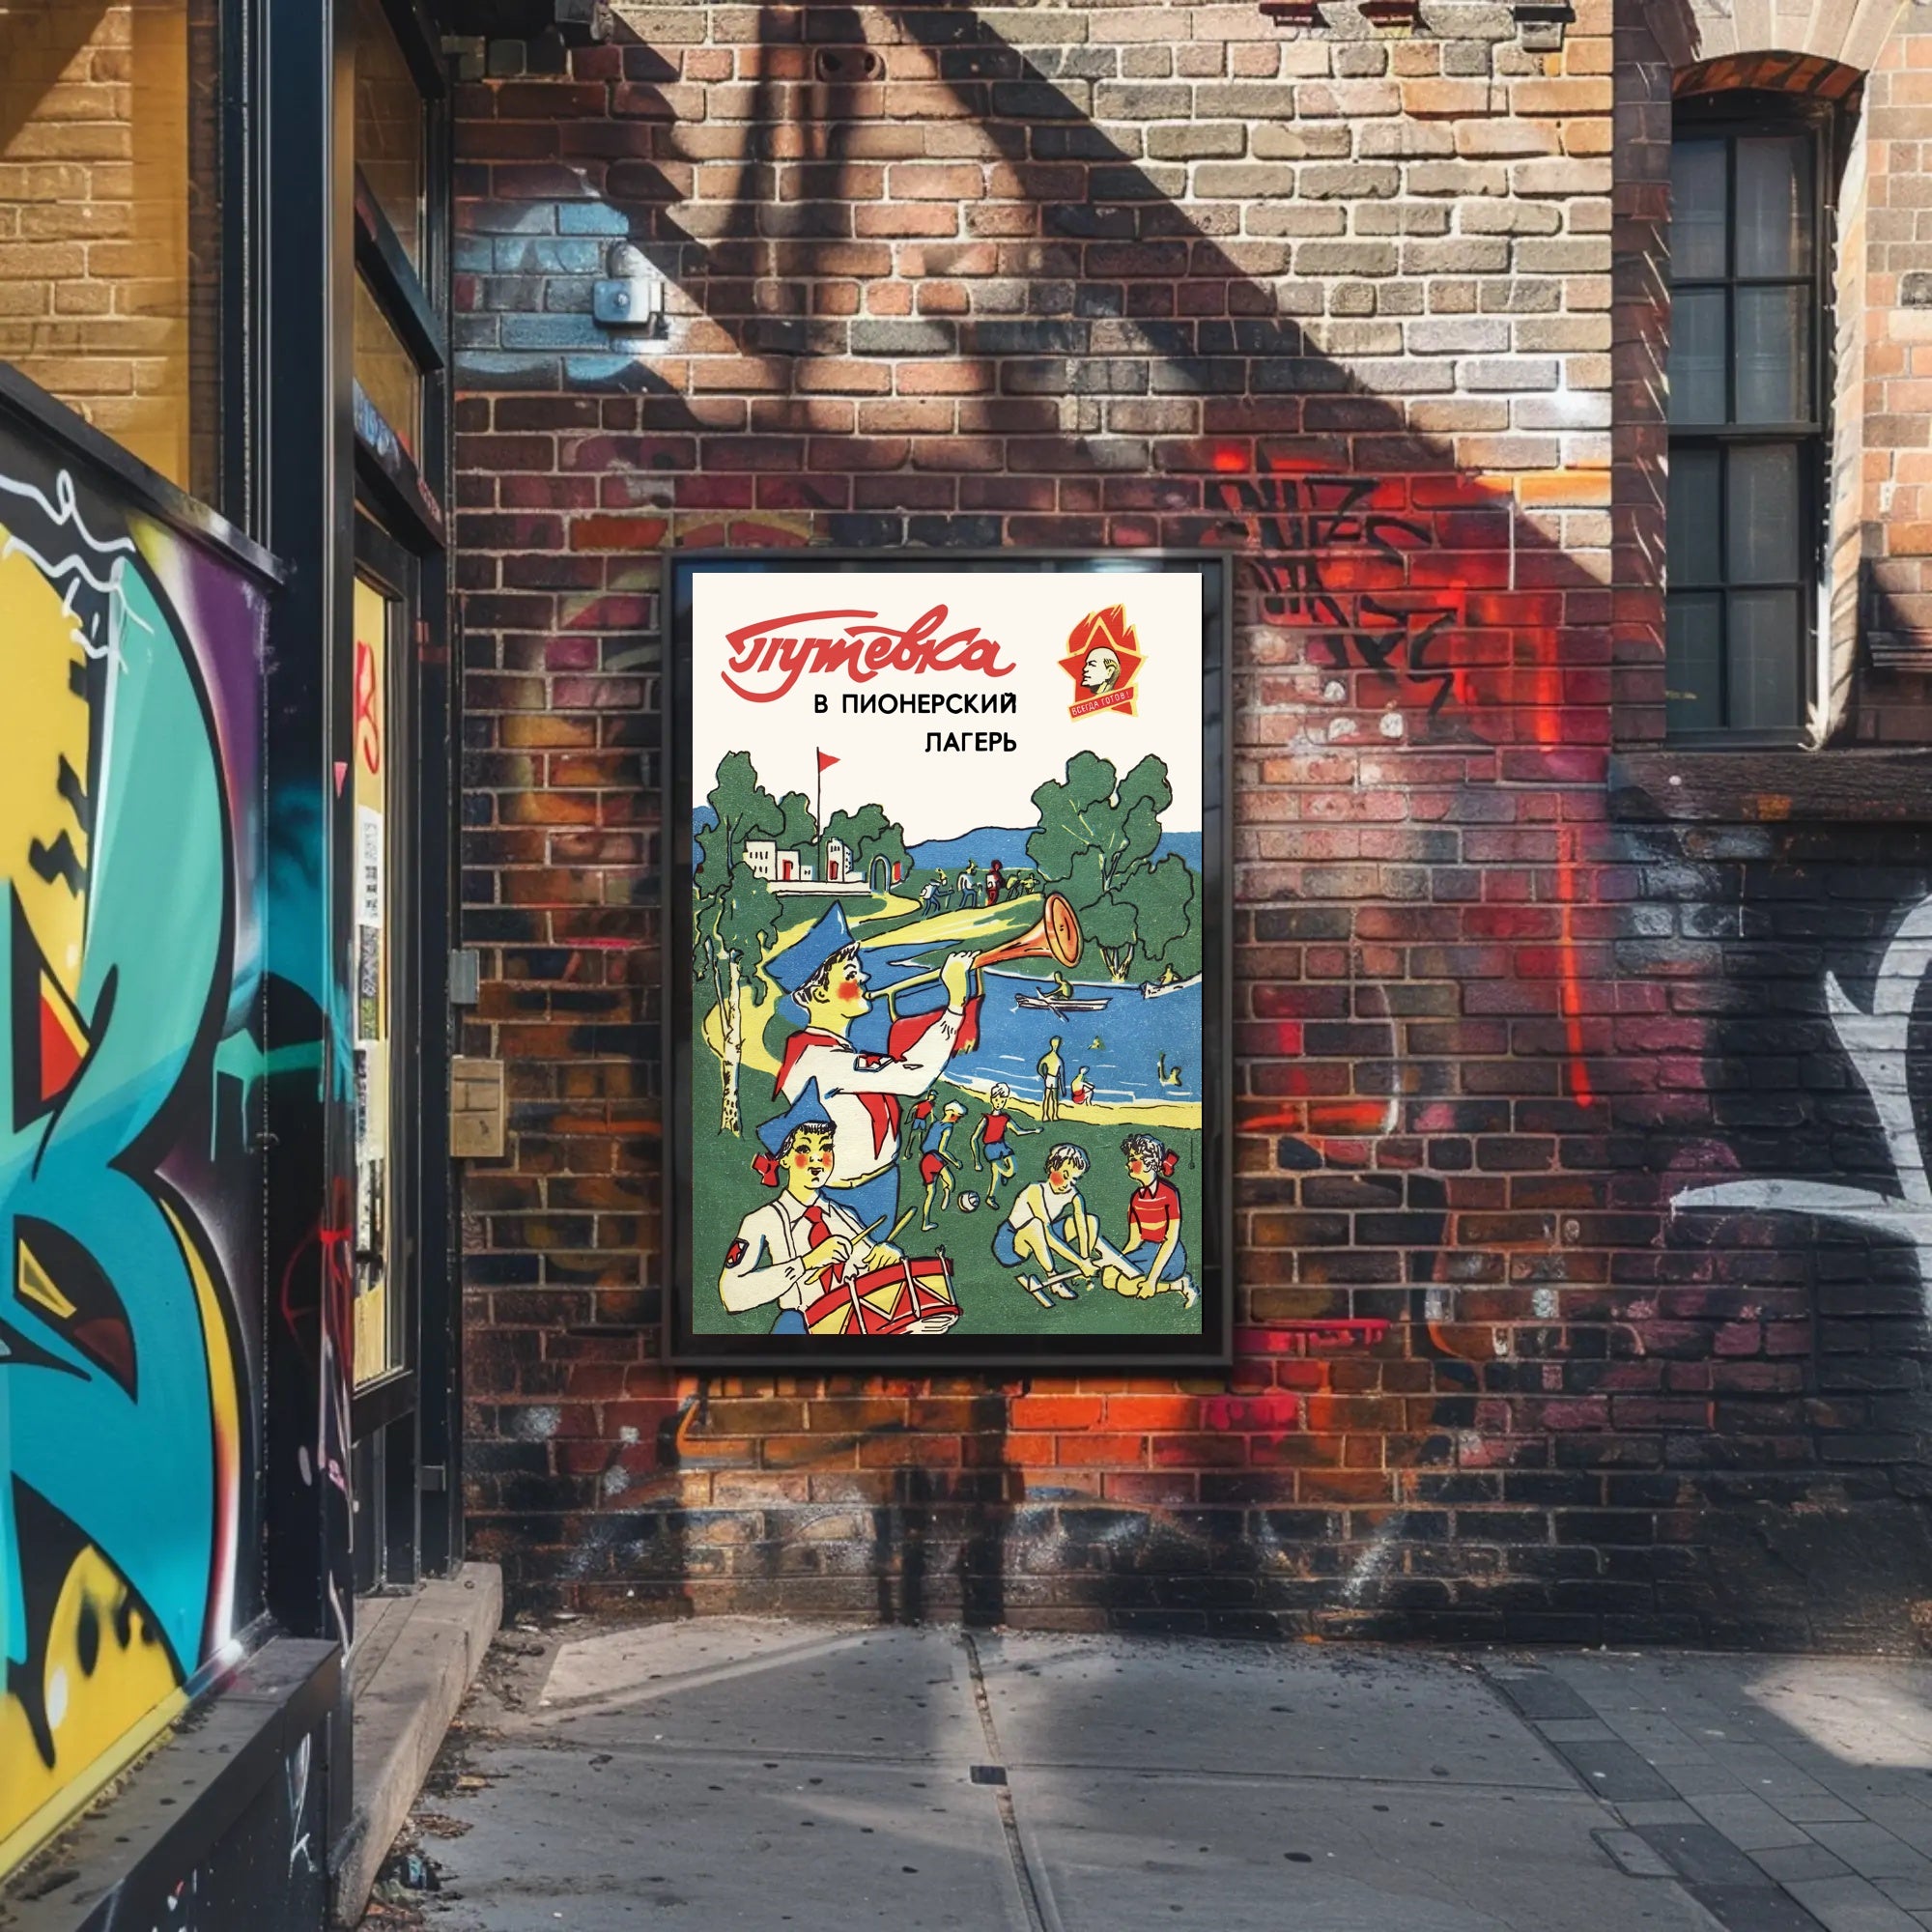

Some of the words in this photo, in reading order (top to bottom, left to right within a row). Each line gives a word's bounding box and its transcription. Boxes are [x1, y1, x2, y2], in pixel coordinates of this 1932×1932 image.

[722, 605, 1015, 702] Путевка
[815, 695, 829, 713] В
[842, 693, 1017, 714] ПИОНЕРСКИЙ
[1071, 700, 1099, 716] ВСЕГДА
[1101, 691, 1130, 706] ГОТОВ!
[924, 732, 1017, 753] ЛАГЕРЬ
